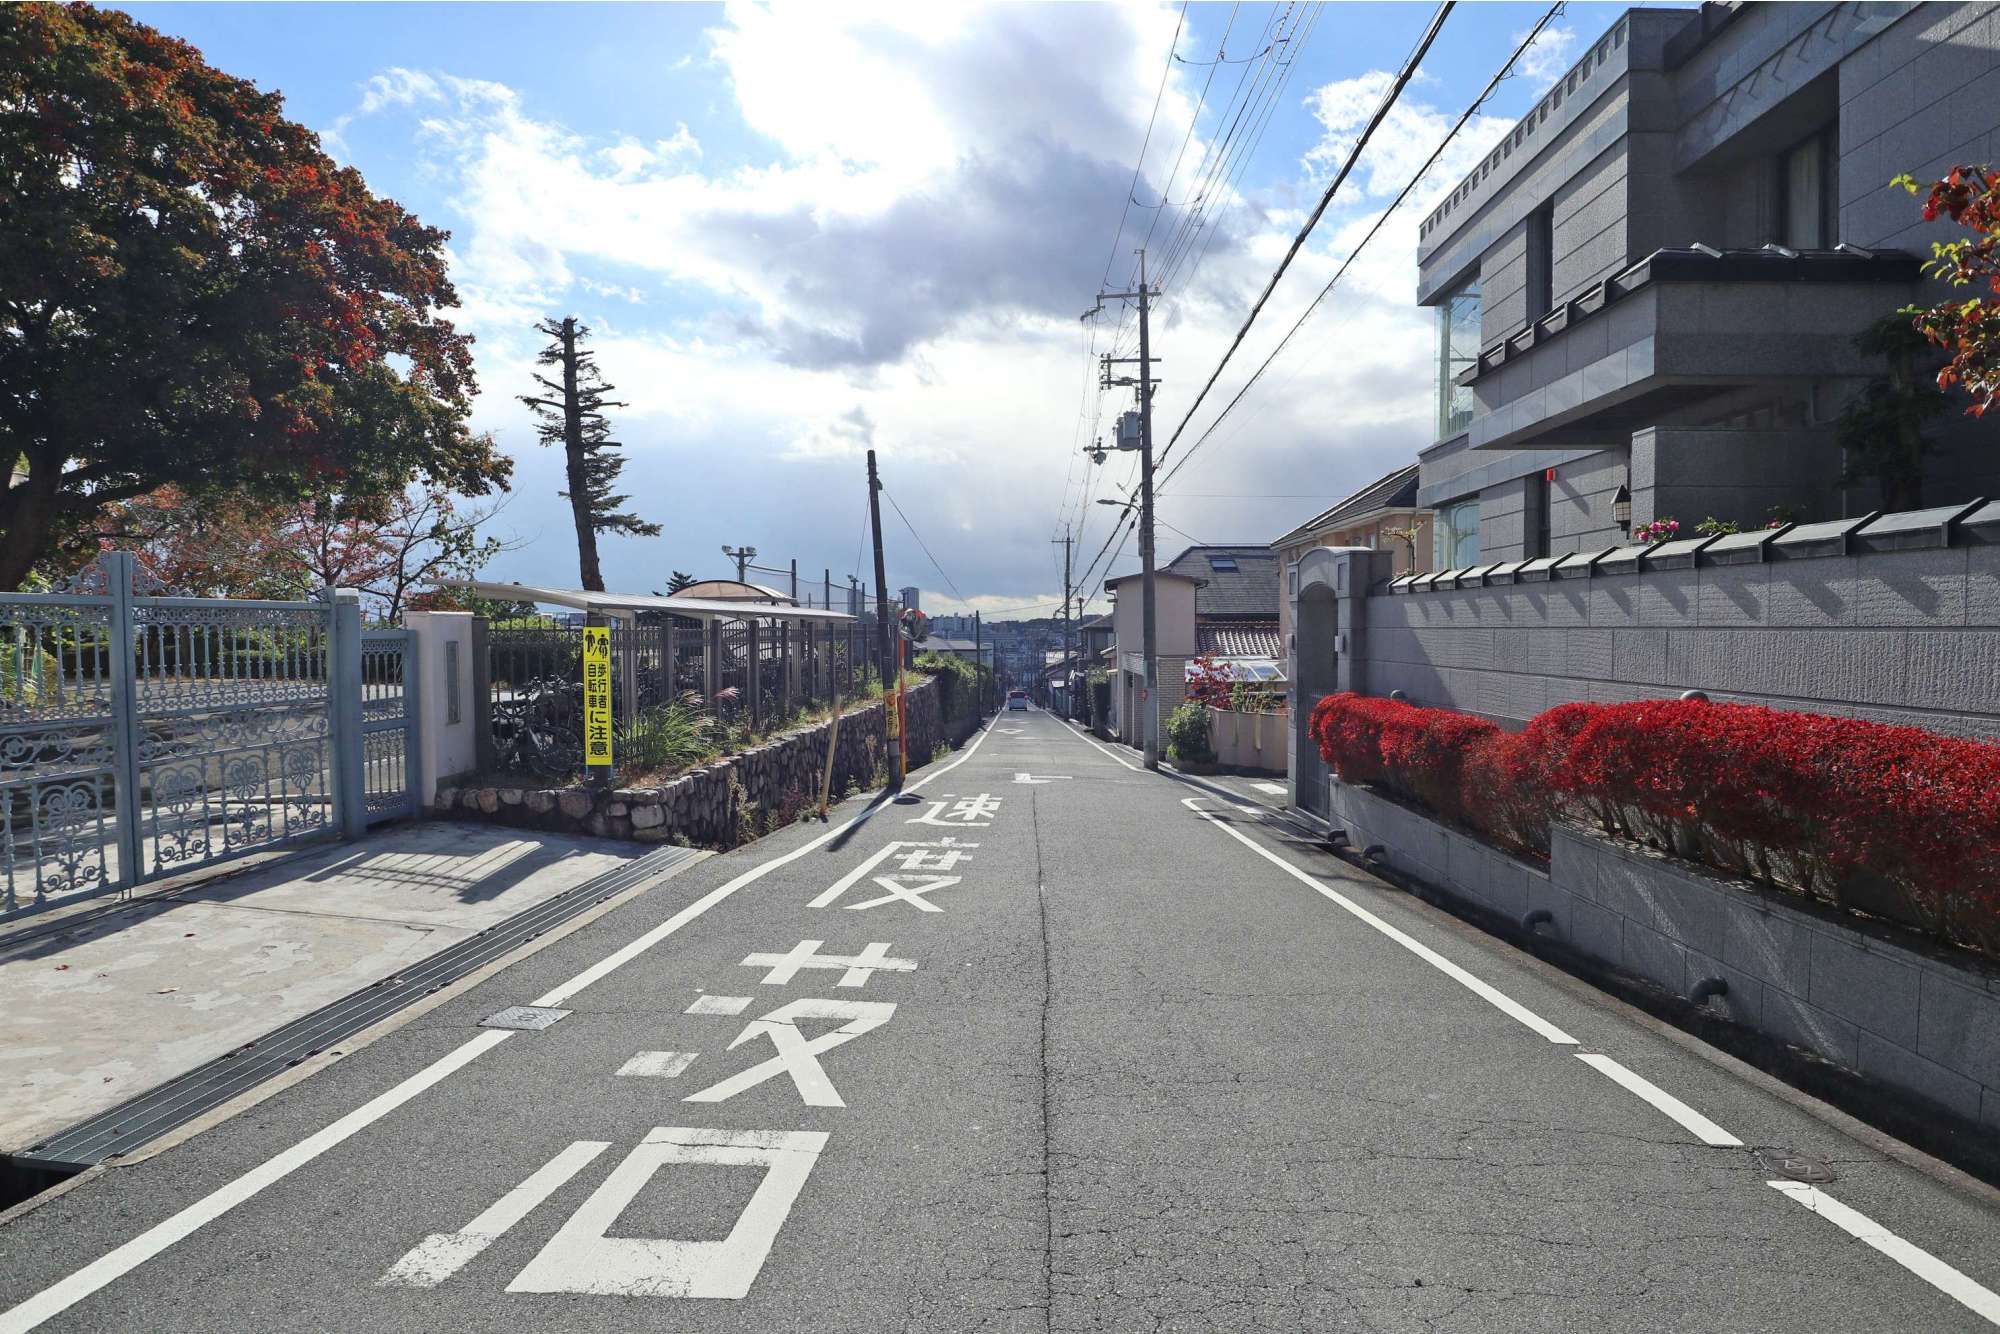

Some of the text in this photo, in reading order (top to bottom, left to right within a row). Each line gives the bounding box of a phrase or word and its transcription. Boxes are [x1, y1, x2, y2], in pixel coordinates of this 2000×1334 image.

[587, 663, 597, 709] 自転車
[597, 663, 608, 709] 歩行者
[589, 710, 609, 757] に注意
[376, 793, 1003, 1299] 速度落
